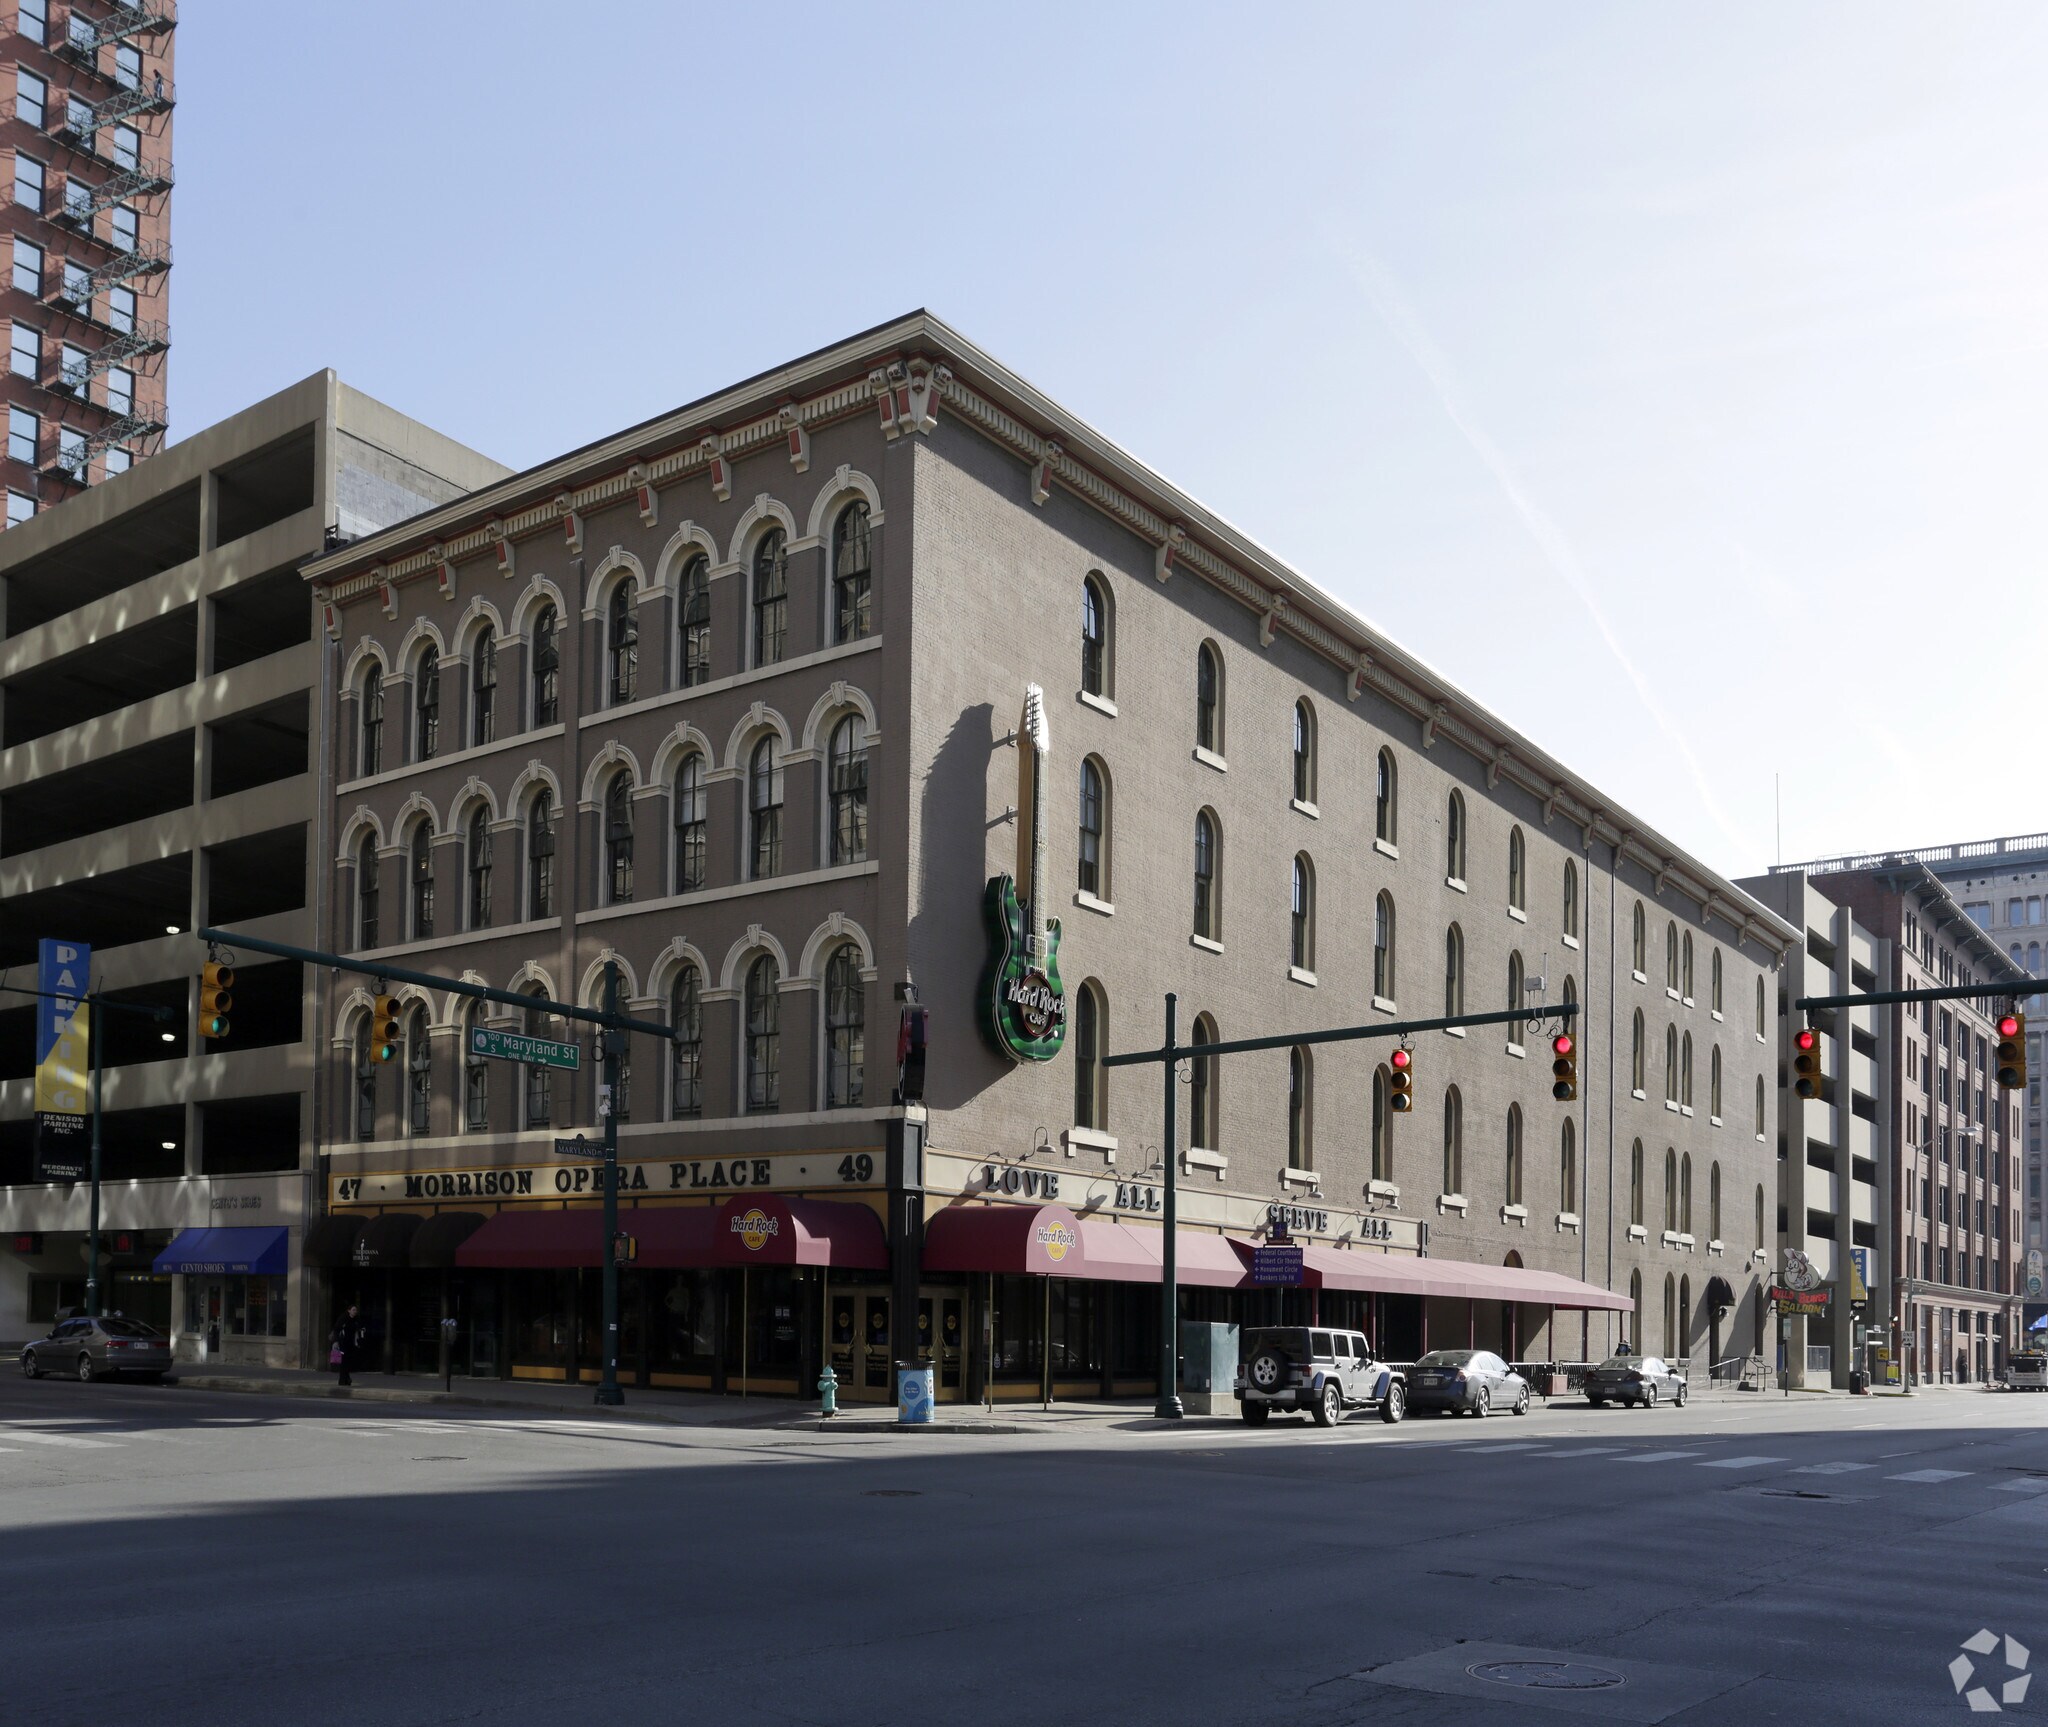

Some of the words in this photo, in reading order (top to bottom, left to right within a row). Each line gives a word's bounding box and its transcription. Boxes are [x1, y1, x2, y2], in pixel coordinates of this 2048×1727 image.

[1008, 977, 1040, 1008] Hard
[1040, 986, 1066, 1022] Rock
[54, 945, 78, 1109] PARKING
[488, 1033, 500, 1042] 100
[490, 1044, 497, 1054] S
[503, 1036, 557, 1057] Maryland
[563, 1047, 575, 1060] St
[508, 1052, 520, 1061] ONE
[522, 1054, 535, 1063] WAY
[43, 1114, 85, 1123] DENISON
[43, 1120, 85, 1130] PARKING
[558, 1145, 597, 1156] MARYLAND
[41, 1164, 83, 1172] MERCHANTS
[47, 1169, 78, 1177] PARKING
[338, 1178, 363, 1201] 47
[405, 1170, 533, 1199] MORRISON
[555, 1166, 649, 1193] OPERA
[670, 1159, 772, 1189] PLACE
[838, 1154, 875, 1182] 49
[982, 1164, 1059, 1199] LOVE
[1115, 1183, 1162, 1211] ALL
[731, 1216, 755, 1232] Hard
[755, 1217, 779, 1236] Rock
[1267, 1204, 1328, 1232] SERVE
[1361, 1217, 1393, 1240] ALL
[1037, 1226, 1057, 1243] Hard
[1057, 1228, 1076, 1248] Rock
[1277, 1249, 1302, 1257] Courthouse
[181, 1262, 203, 1273] CENTO
[203, 1262, 225, 1273] SHOES
[1778, 1300, 1822, 1314] SALOON
